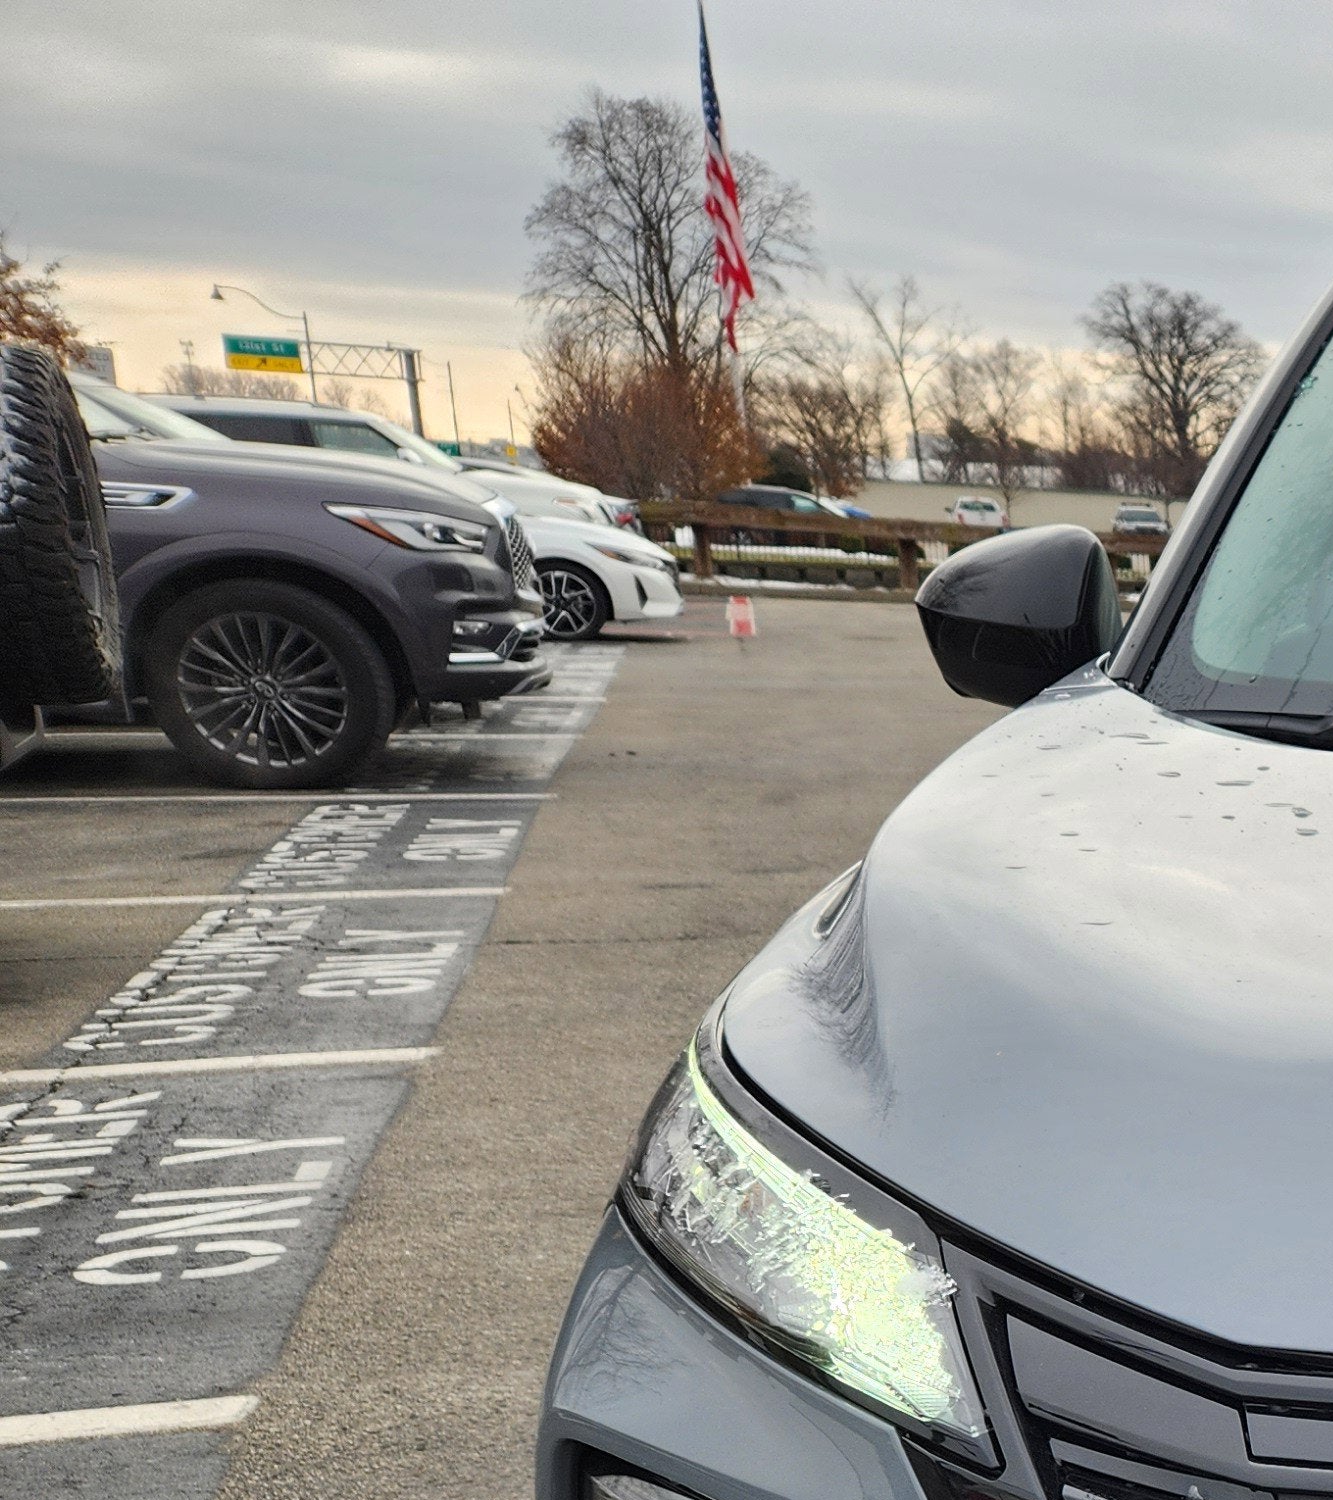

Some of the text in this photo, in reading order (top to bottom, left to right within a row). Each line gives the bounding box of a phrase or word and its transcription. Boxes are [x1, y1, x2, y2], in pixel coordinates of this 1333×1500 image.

[239, 803, 410, 888] CUSTOMER
[402, 818, 522, 861] ONLY
[62, 905, 326, 1051] CUSTOMER
[298, 929, 465, 998] ONLY
[72, 1137, 346, 1285] ONLY
